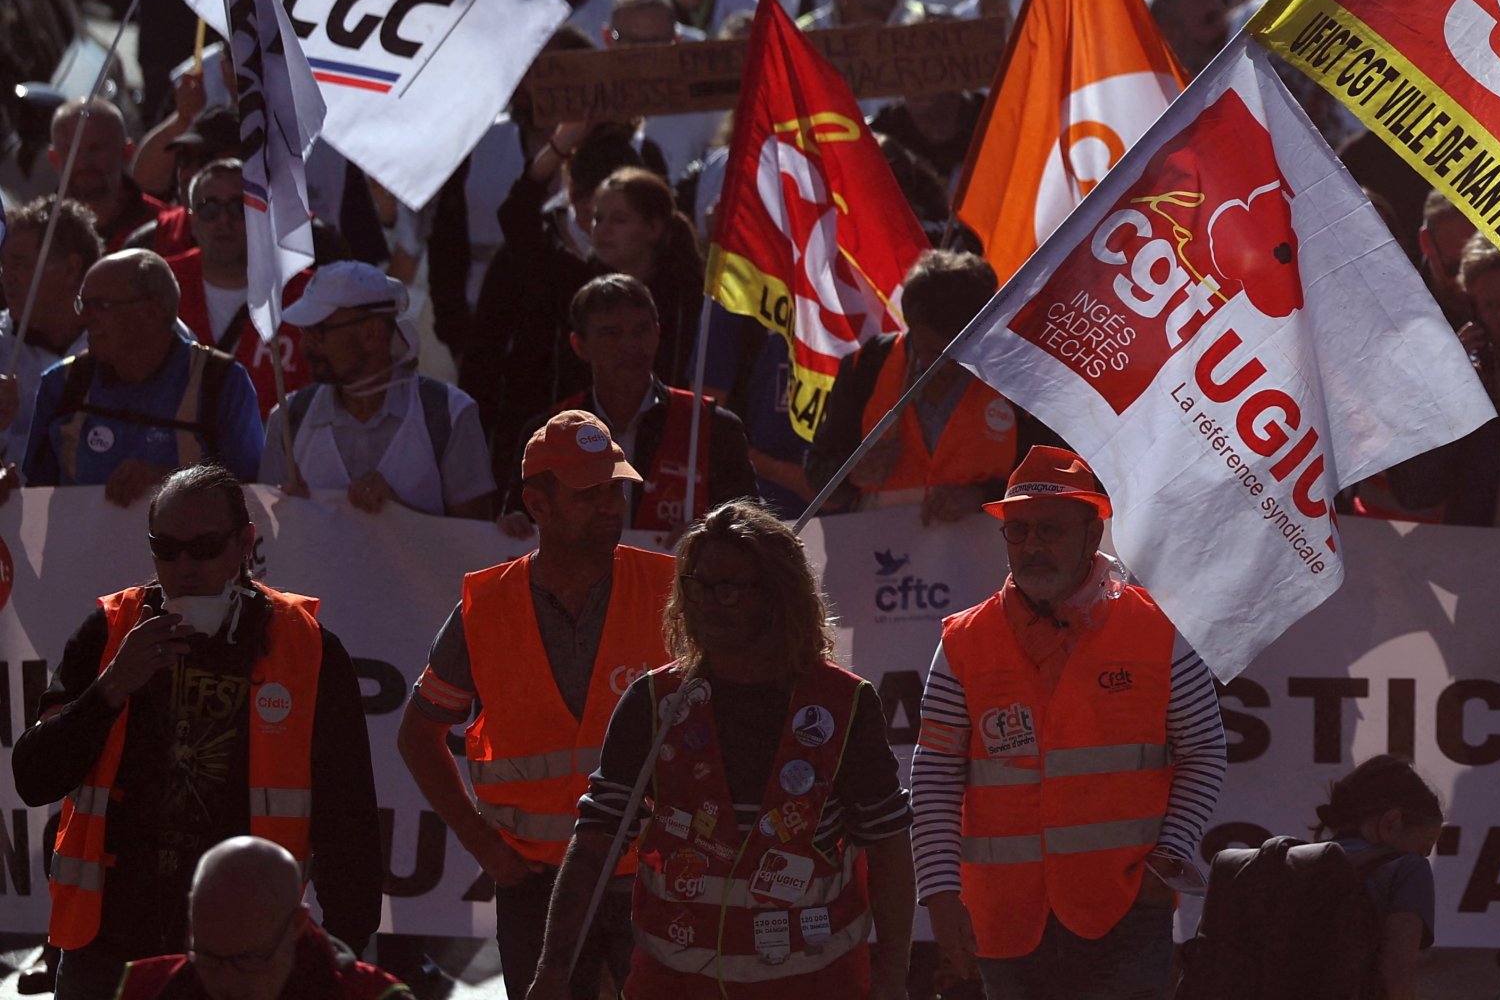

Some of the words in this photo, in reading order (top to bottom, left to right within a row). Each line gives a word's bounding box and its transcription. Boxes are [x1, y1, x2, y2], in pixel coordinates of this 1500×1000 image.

[1290, 12, 1363, 75] UFICT
[1336, 48, 1401, 107] CGT
[1375, 79, 1452, 155] VILLE
[1423, 124, 1479, 179] DE
[1046, 302, 1130, 372] CADRES
[1069, 290, 1137, 347] INGÉS
[1038, 322, 1107, 380] TECHS
[1091, 208, 1222, 350] cgt
[1195, 328, 1338, 553] UGIC
[1170, 382, 1195, 414] La
[1193, 410, 1264, 497] référence
[1261, 495, 1326, 575] syndicale
[876, 576, 951, 613] cftc
[257, 696, 289, 710] Cfdt:
[1097, 667, 1134, 689] Cfdt
[981, 704, 1033, 740] Cfdt
[674, 876, 705, 898] cgt
[775, 874, 806, 889] UGICT
[667, 922, 696, 946] cgt
